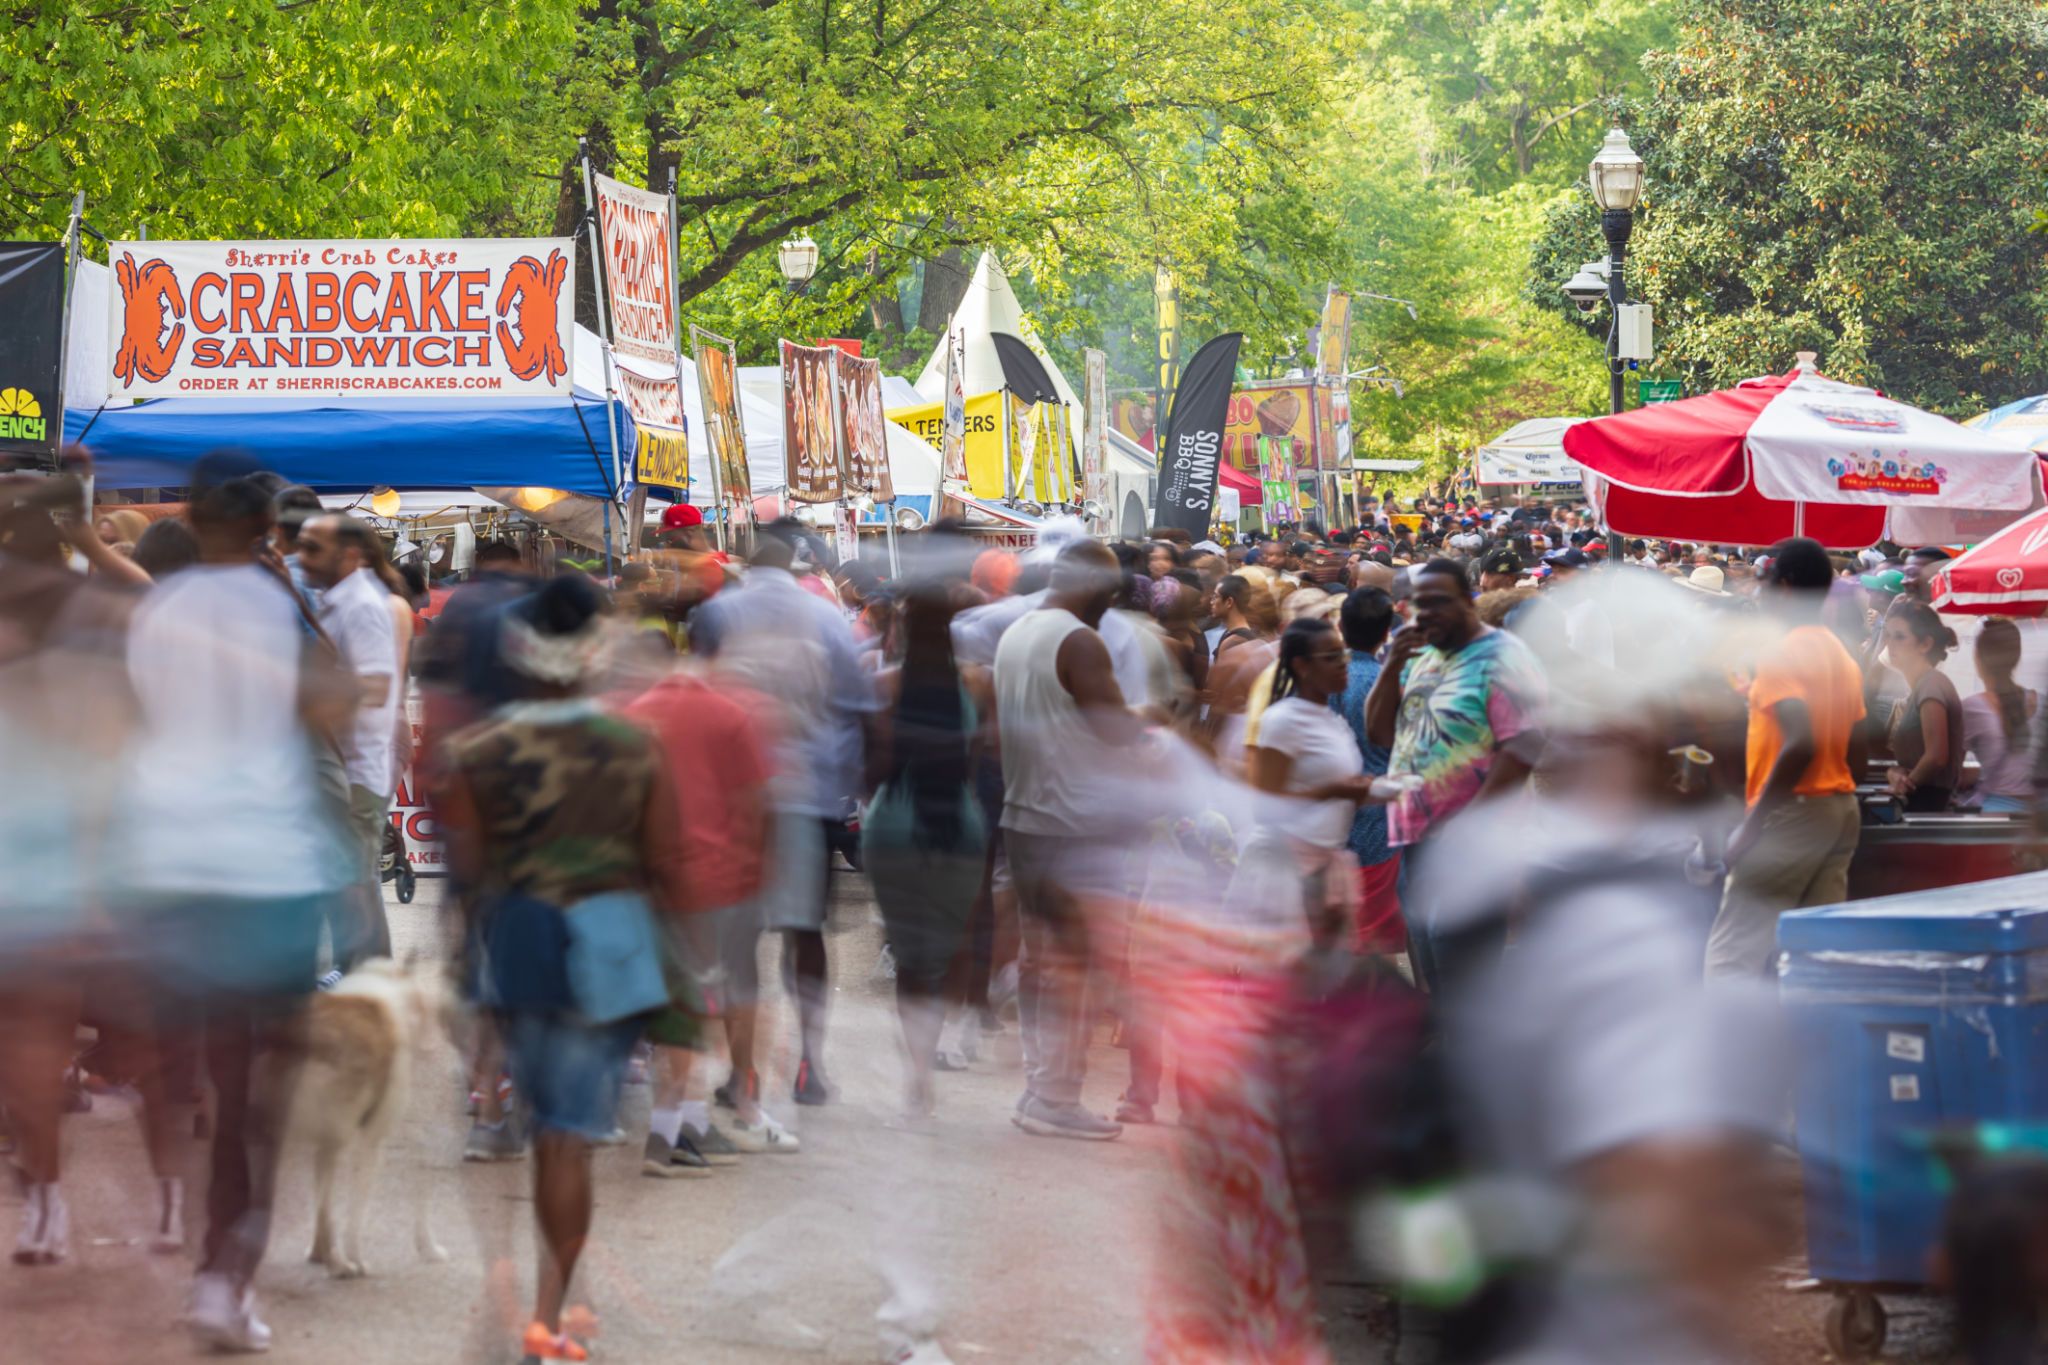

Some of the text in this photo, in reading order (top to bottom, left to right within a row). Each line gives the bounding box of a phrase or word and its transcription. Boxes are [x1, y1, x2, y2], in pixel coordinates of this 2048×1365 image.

[225, 247, 458, 270] Sherri's Crab Cakes
[190, 268, 491, 334] CRABCAKE
[191, 336, 492, 368] SANDWICH
[179, 376, 502, 390] ORDER AT SHERRISCRABCAKES.COM
[916, 415, 995, 435] TENERS
[1173, 433, 1195, 470] BBQ
[1185, 430, 1220, 511] SONNY'S
